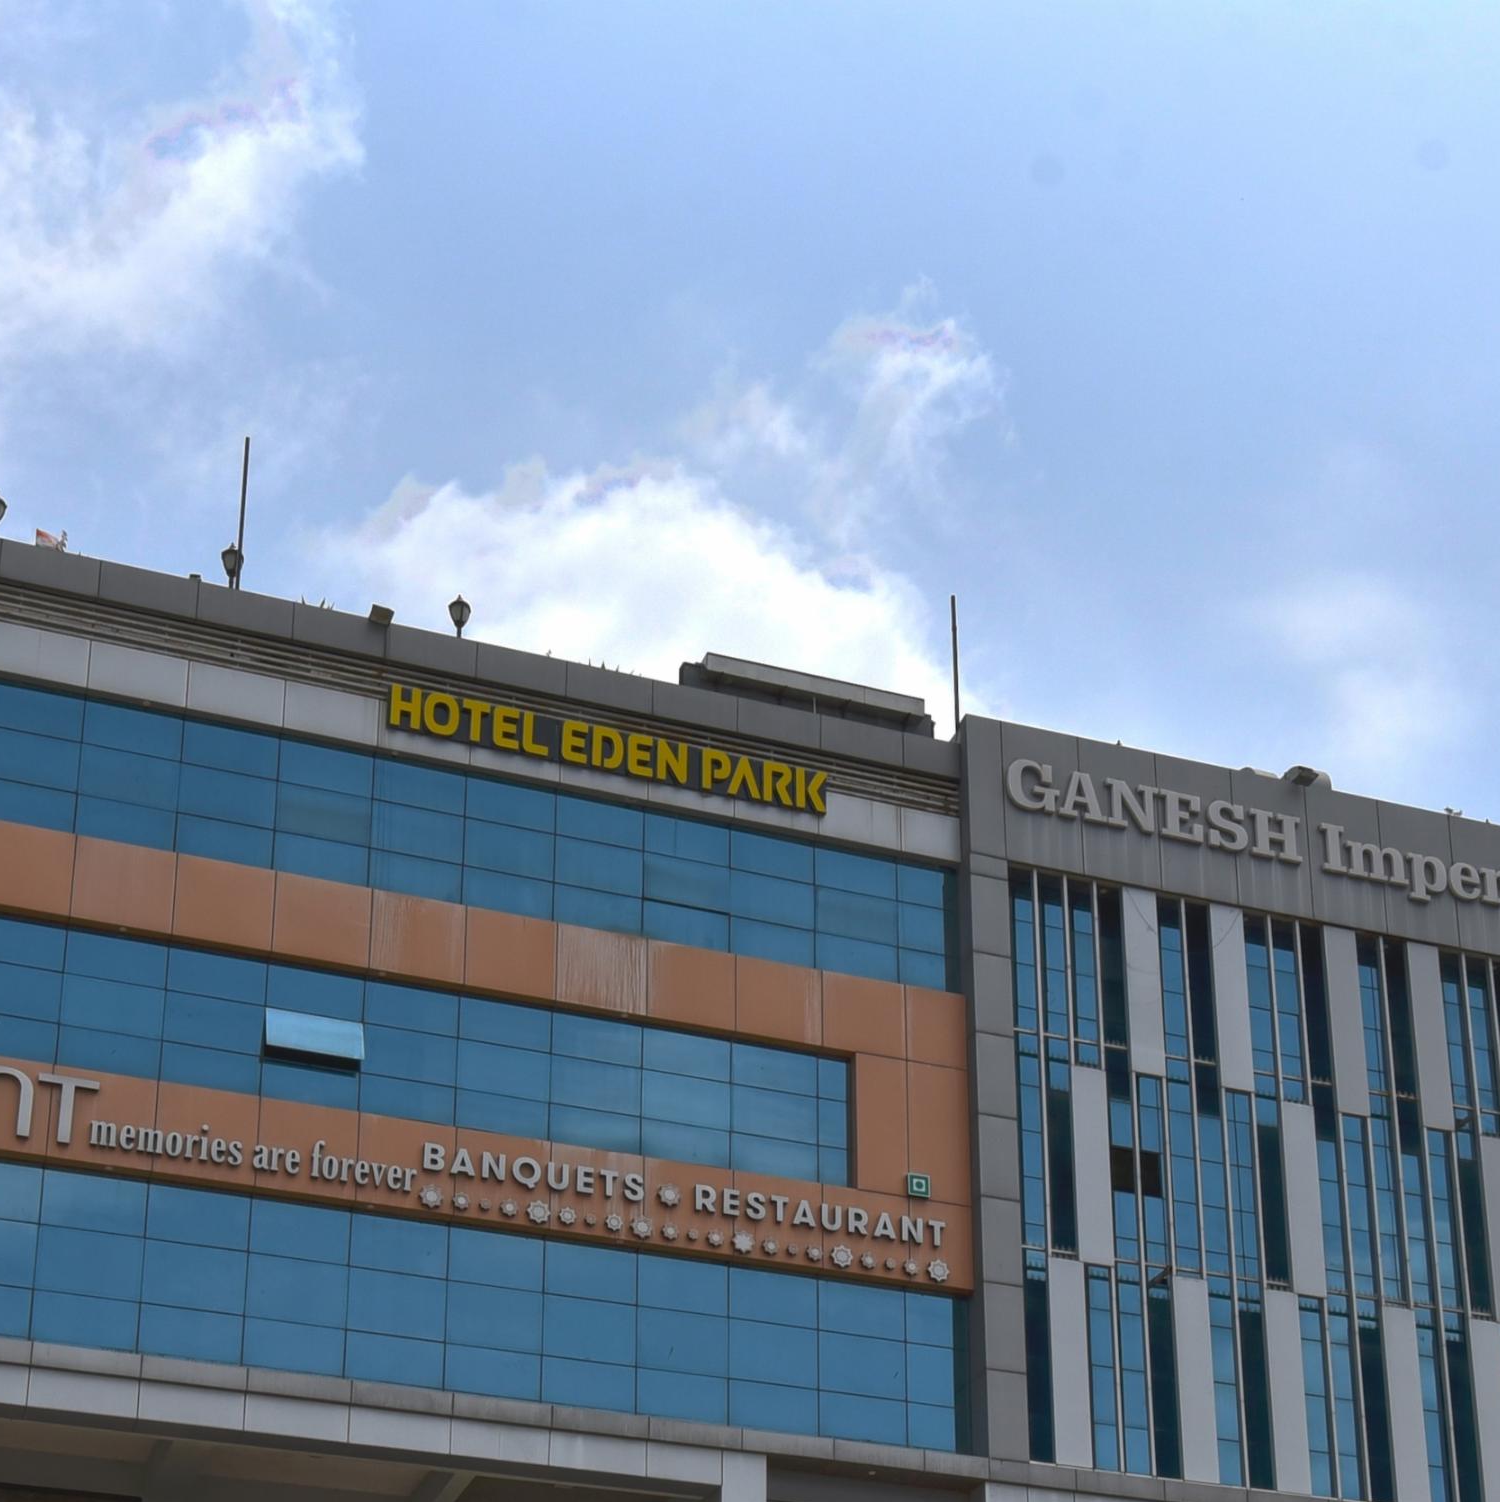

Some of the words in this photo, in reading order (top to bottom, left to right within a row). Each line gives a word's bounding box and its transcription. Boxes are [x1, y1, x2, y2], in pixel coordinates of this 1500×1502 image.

[388, 683, 550, 757] HOTEL
[560, 719, 689, 784] EDEN
[702, 747, 828, 814] PARK
[1006, 757, 1302, 864] GANESH
[89, 1119, 244, 1167] memories
[252, 1144, 301, 1176] are
[310, 1139, 418, 1194] forever
[423, 1141, 645, 1202] BANQUETS
[694, 1183, 948, 1248] RESTAURANT
